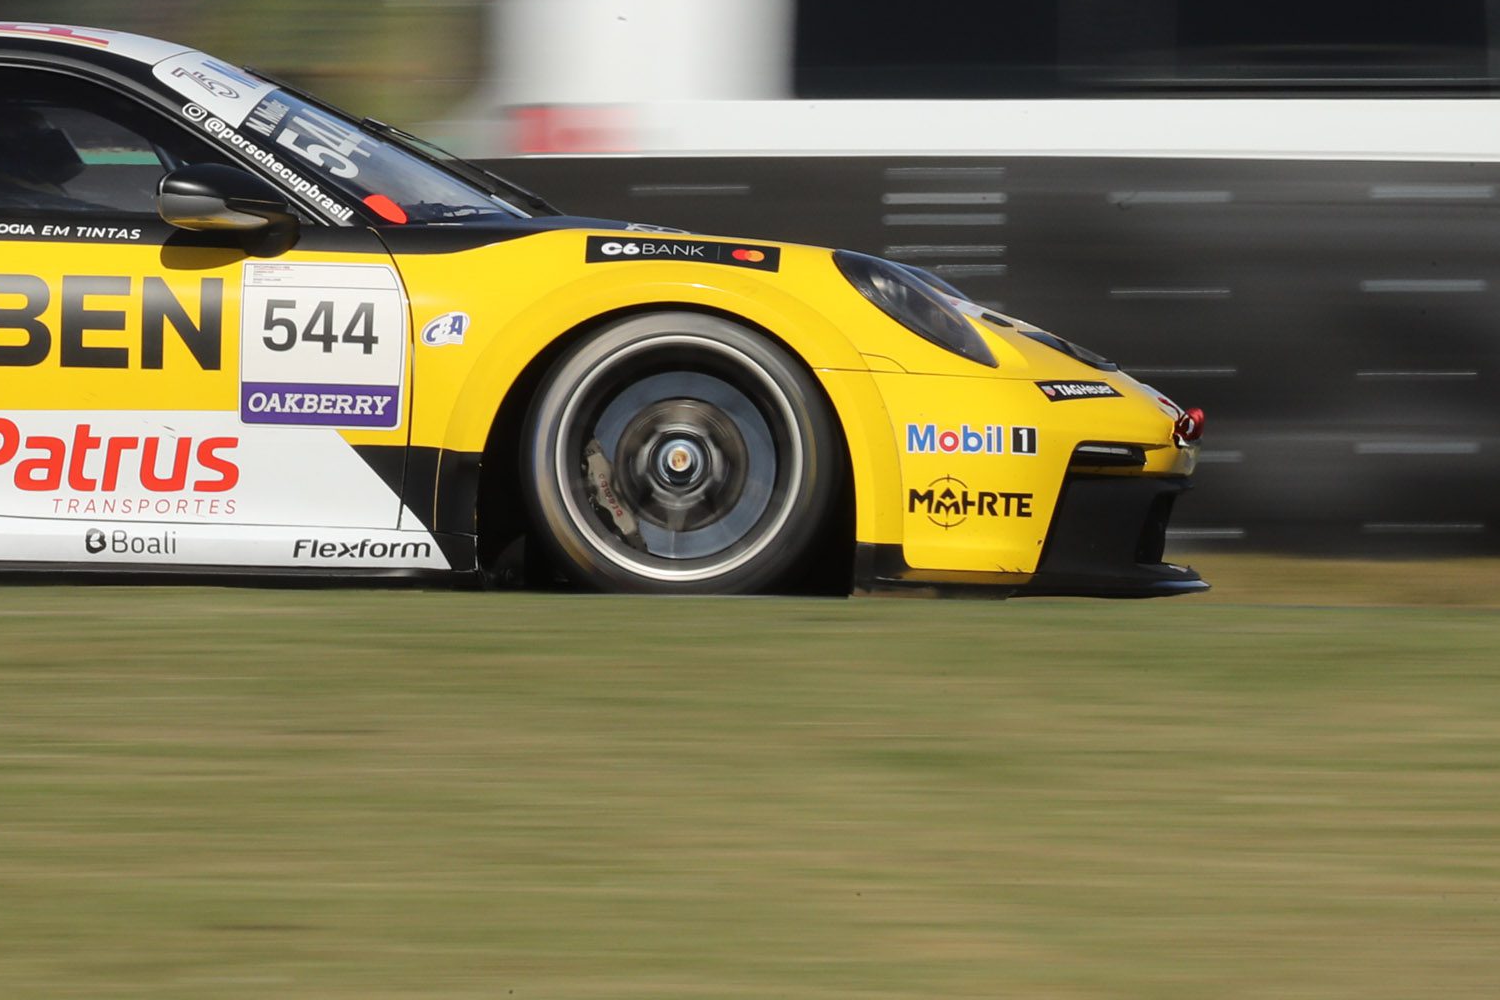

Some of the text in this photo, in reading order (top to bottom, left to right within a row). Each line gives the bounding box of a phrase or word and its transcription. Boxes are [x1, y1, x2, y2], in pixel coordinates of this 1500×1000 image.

[204, 116, 355, 221] @porschecupbrasil
[41, 225, 70, 237] EM
[76, 227, 142, 240] TINTAS
[262, 298, 379, 355] 544
[248, 391, 392, 416] OAKBERRY
[907, 423, 1003, 453] Mobil
[52, 498, 237, 515] TRANSPORTES
[111, 529, 177, 555] Boali
[292, 538, 432, 559] Flexform
